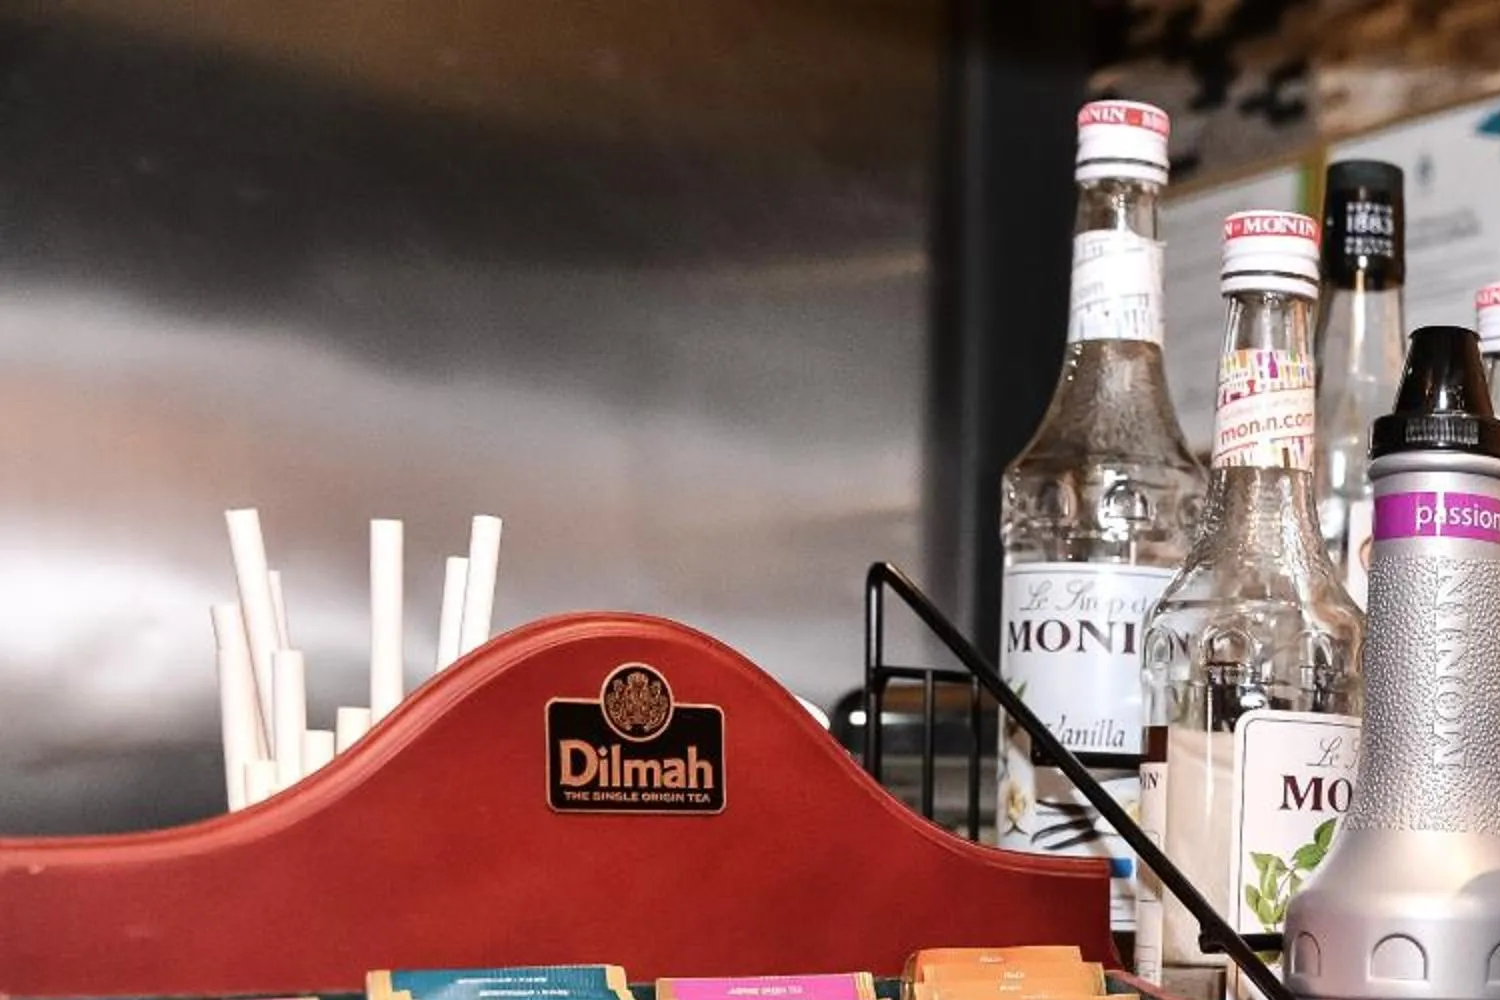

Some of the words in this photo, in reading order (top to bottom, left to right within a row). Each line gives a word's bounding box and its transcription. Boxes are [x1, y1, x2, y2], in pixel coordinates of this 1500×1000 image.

[1242, 216, 1316, 236] MONIN
[1219, 412, 1313, 445] monn.co
[1007, 618, 1137, 655] MONI
[559, 738, 714, 789] Dilmah
[564, 791, 589, 801] THE
[687, 794, 711, 804] TEA
